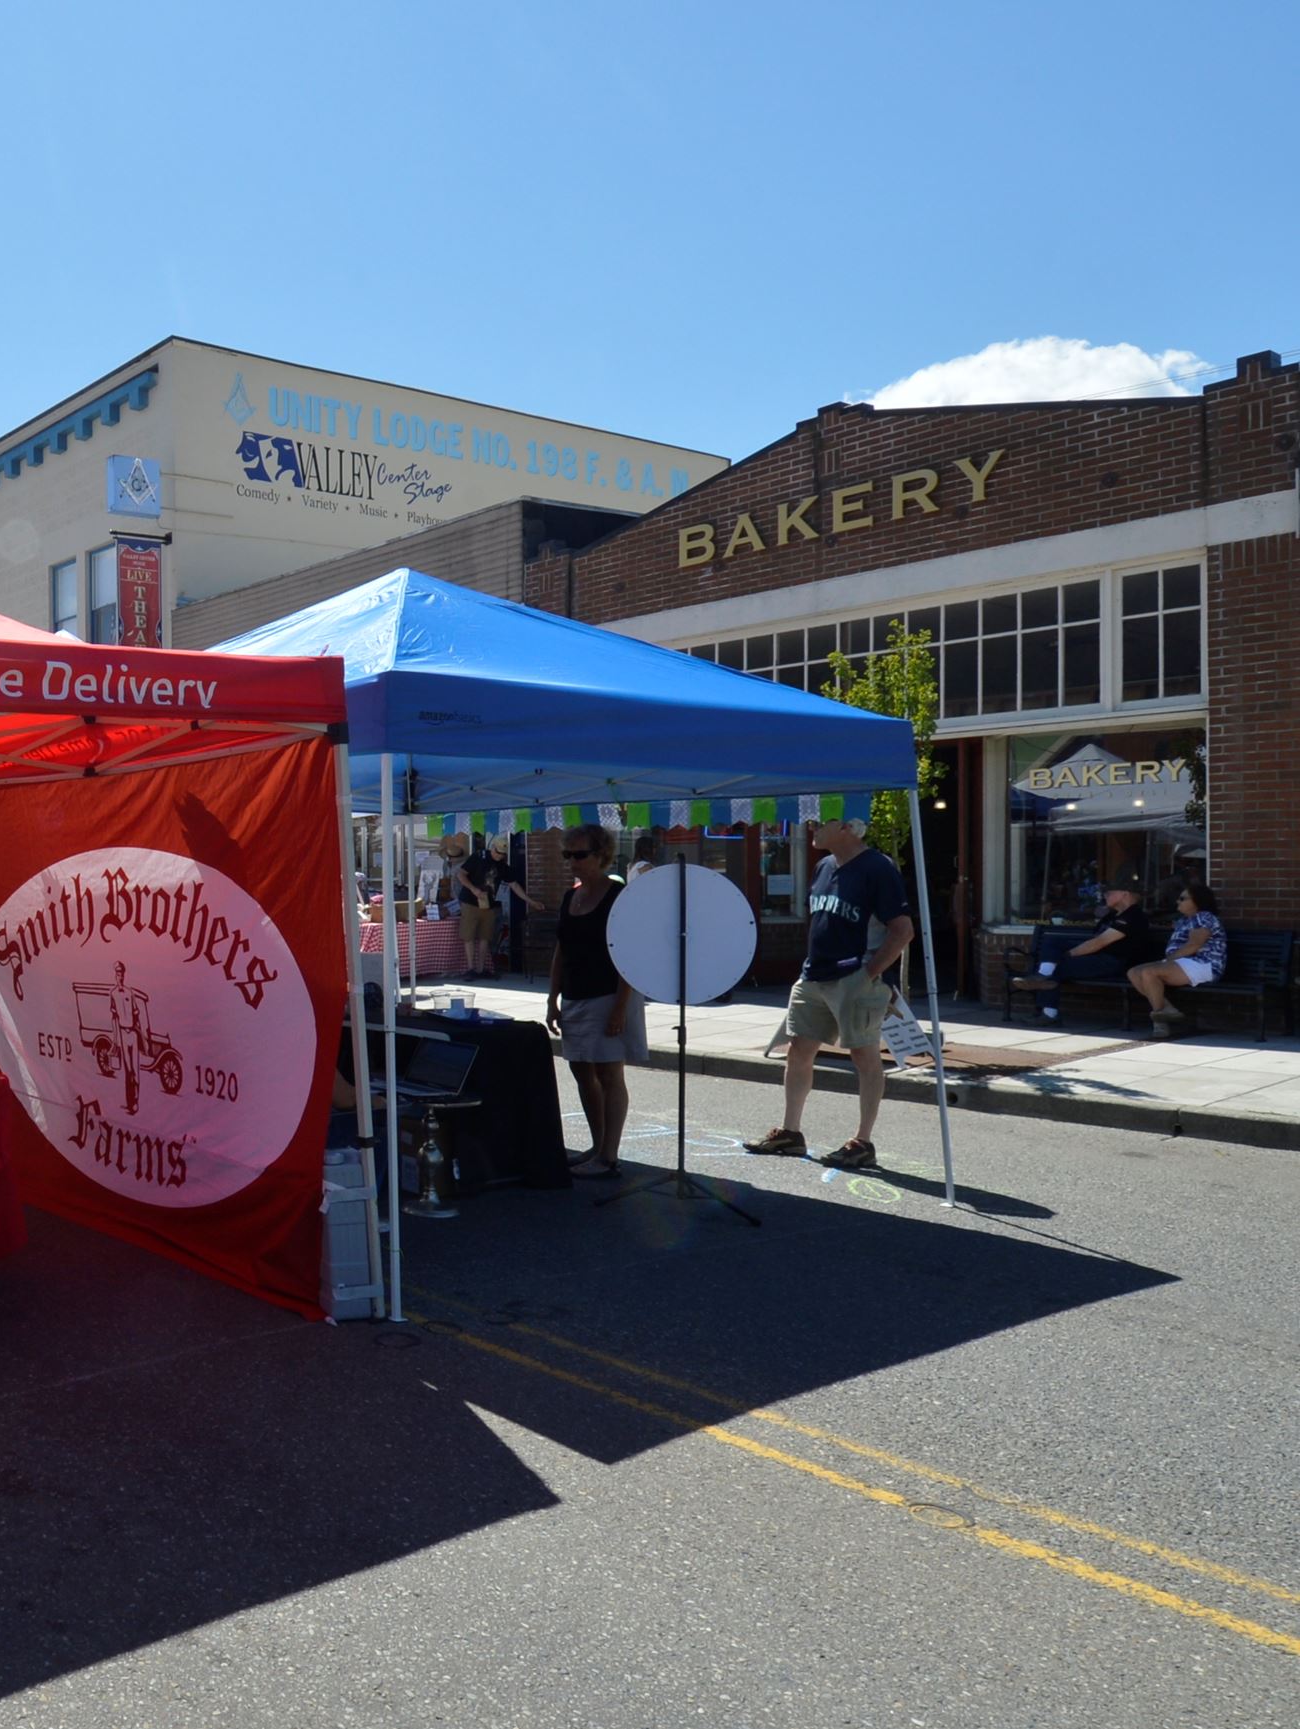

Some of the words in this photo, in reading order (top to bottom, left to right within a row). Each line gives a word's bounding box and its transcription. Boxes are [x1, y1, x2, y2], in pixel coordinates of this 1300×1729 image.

[267, 384, 363, 441] UNITY
[372, 406, 465, 461] LODGE
[470, 426, 518, 471] NO.
[525, 439, 578, 481] 198
[583, 449, 608, 487] F.
[614, 457, 634, 492] &
[296, 441, 378, 501] VALLEY
[376, 463, 432, 486] Center
[403, 482, 452, 505] Stage
[236, 483, 281, 505] Comedy
[301, 494, 340, 513] Variety
[359, 503, 388, 519] Music
[678, 449, 1006, 568] BAKERY
[127, 570, 152, 582] LIVE
[134, 586, 147, 648] THEA
[41, 660, 217, 709] Delivery
[1027, 758, 1187, 790] BAKERY
[99, 866, 278, 1011] Brothers
[194, 1065, 239, 1102] 1920
[68, 1095, 188, 1188] Farms
